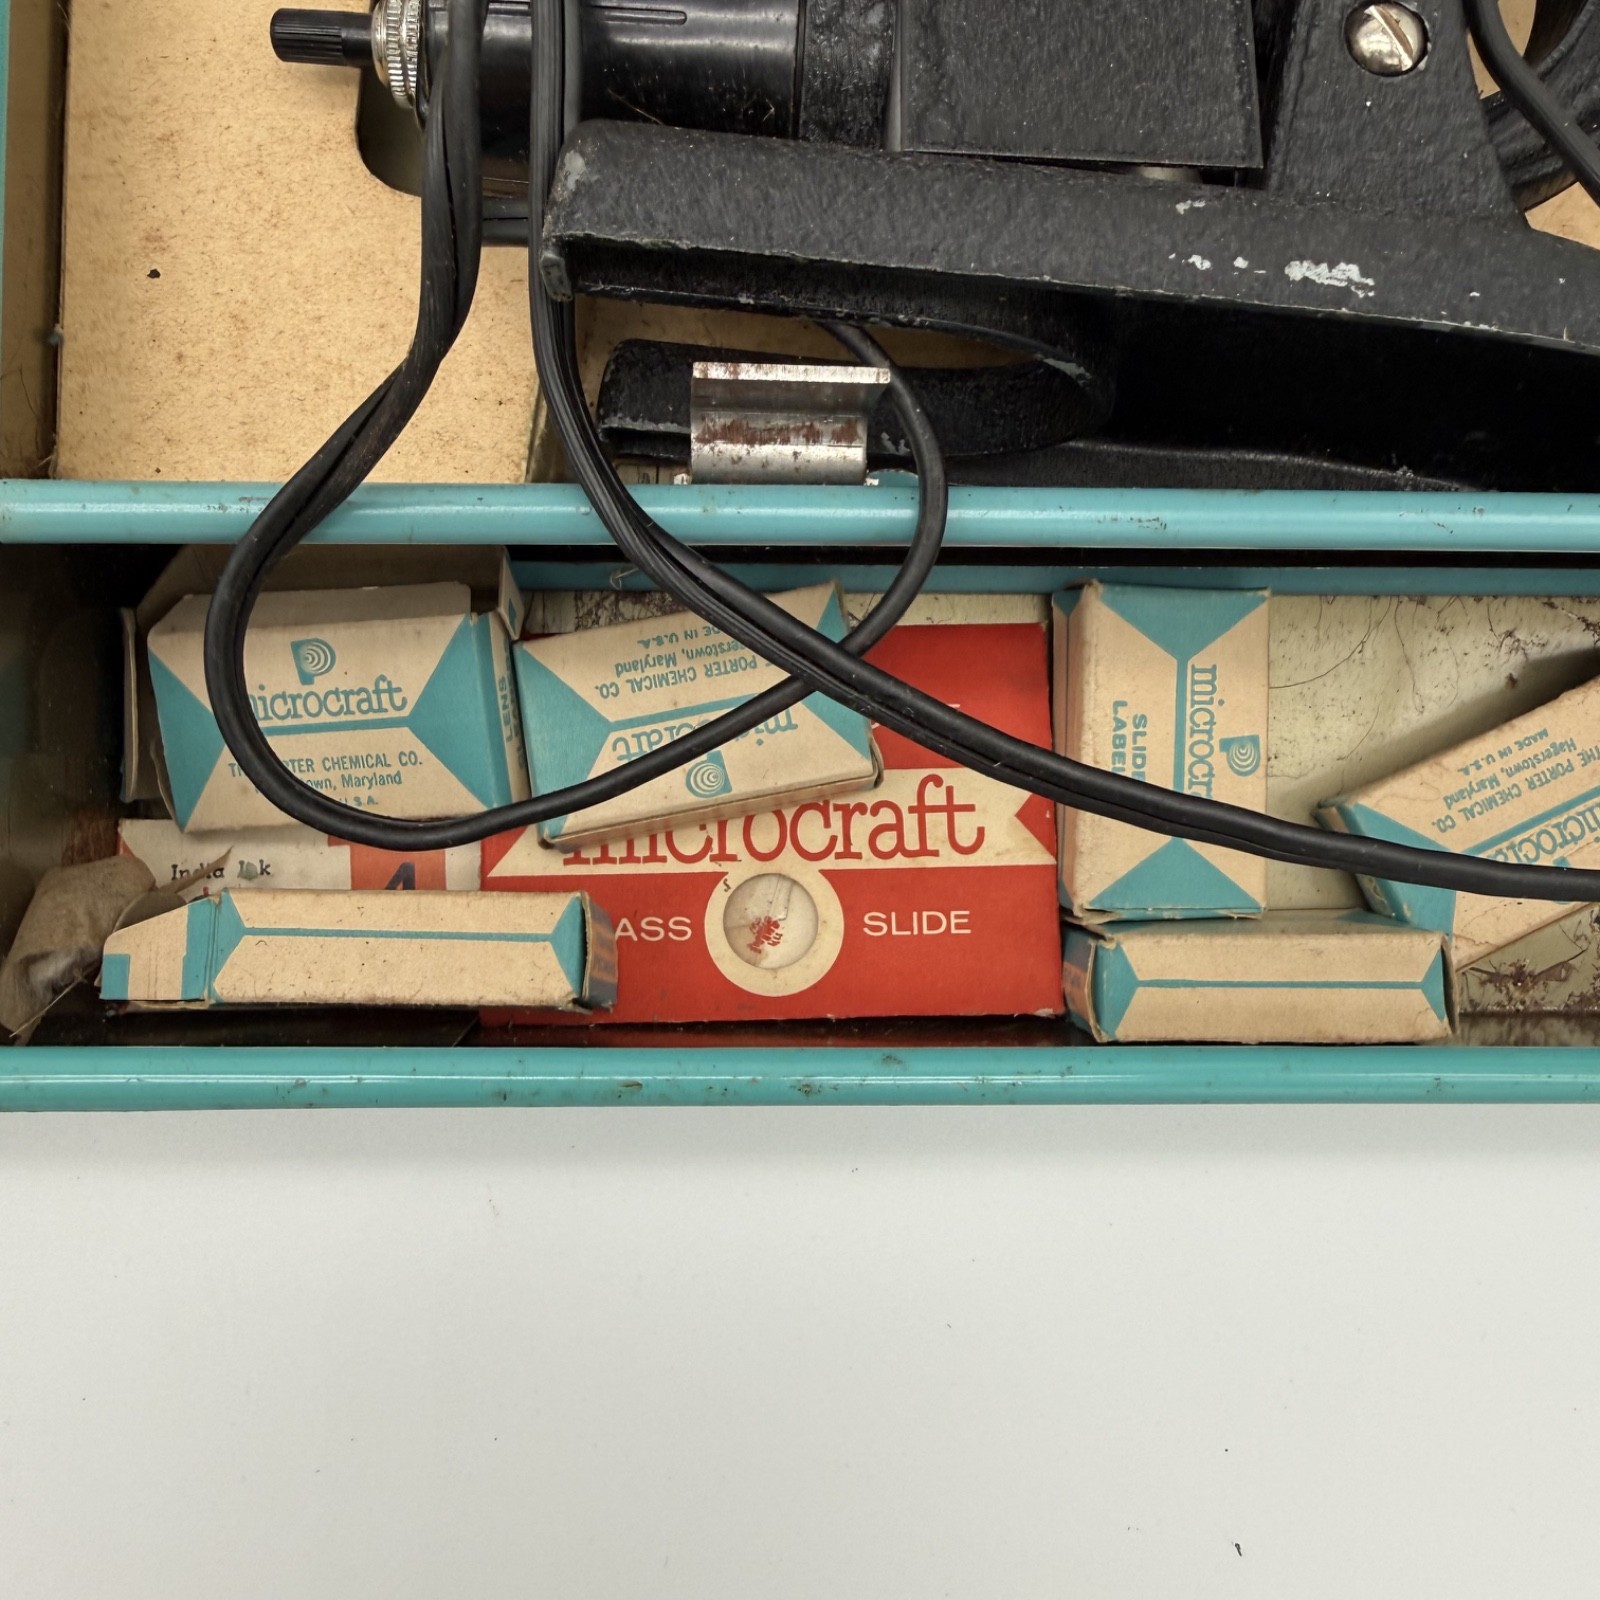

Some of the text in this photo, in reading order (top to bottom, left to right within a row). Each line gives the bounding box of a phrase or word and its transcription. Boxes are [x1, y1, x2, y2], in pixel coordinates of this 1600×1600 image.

[637, 629, 679, 648] U.S.A.
[684, 627, 699, 640] IN
[615, 638, 752, 677] erstown, Maryland
[594, 654, 758, 699] PORTER CHEMICAL CO.
[498, 671, 513, 742] LENS
[612, 708, 799, 761] micraft
[1111, 700, 1128, 775] LABE
[1188, 663, 1225, 800] microcr
[1514, 728, 1549, 751] MADE
[284, 750, 423, 774] TER CHEMICAL CO.
[1498, 746, 1513, 759] IN
[341, 770, 403, 790] Maryland
[1442, 737, 1577, 810] Hagerstown, Maryland
[1525, 759, 1575, 791] PORTER
[1458, 783, 1523, 822] CHEMICAL
[1431, 813, 1457, 834] CO.
[1487, 802, 1600, 865] icrocr
[237, 858, 272, 878] Ik
[615, 910, 972, 942] ASS SLIDE
